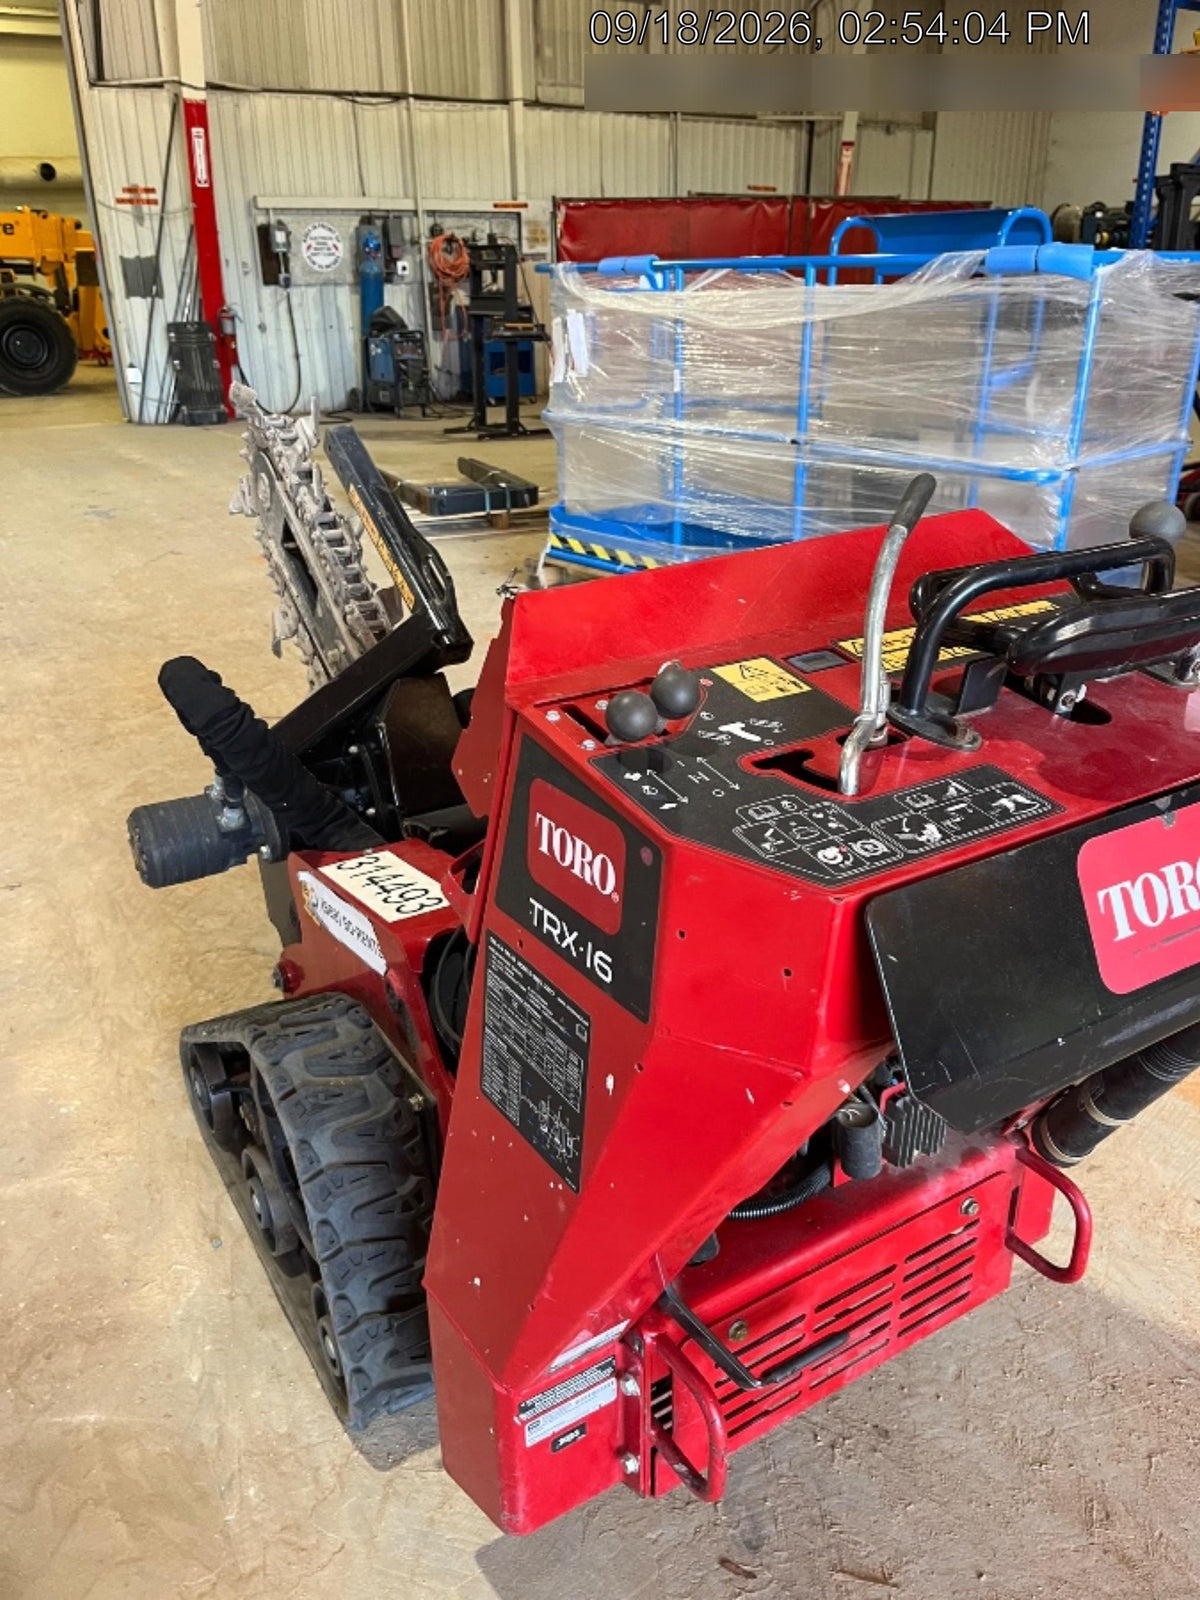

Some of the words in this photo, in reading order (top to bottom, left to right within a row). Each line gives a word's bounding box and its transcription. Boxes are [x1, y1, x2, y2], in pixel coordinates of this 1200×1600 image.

[336, 855, 444, 915] 314493
[535, 812, 616, 895] TORO
[1097, 856, 1200, 942] TOR
